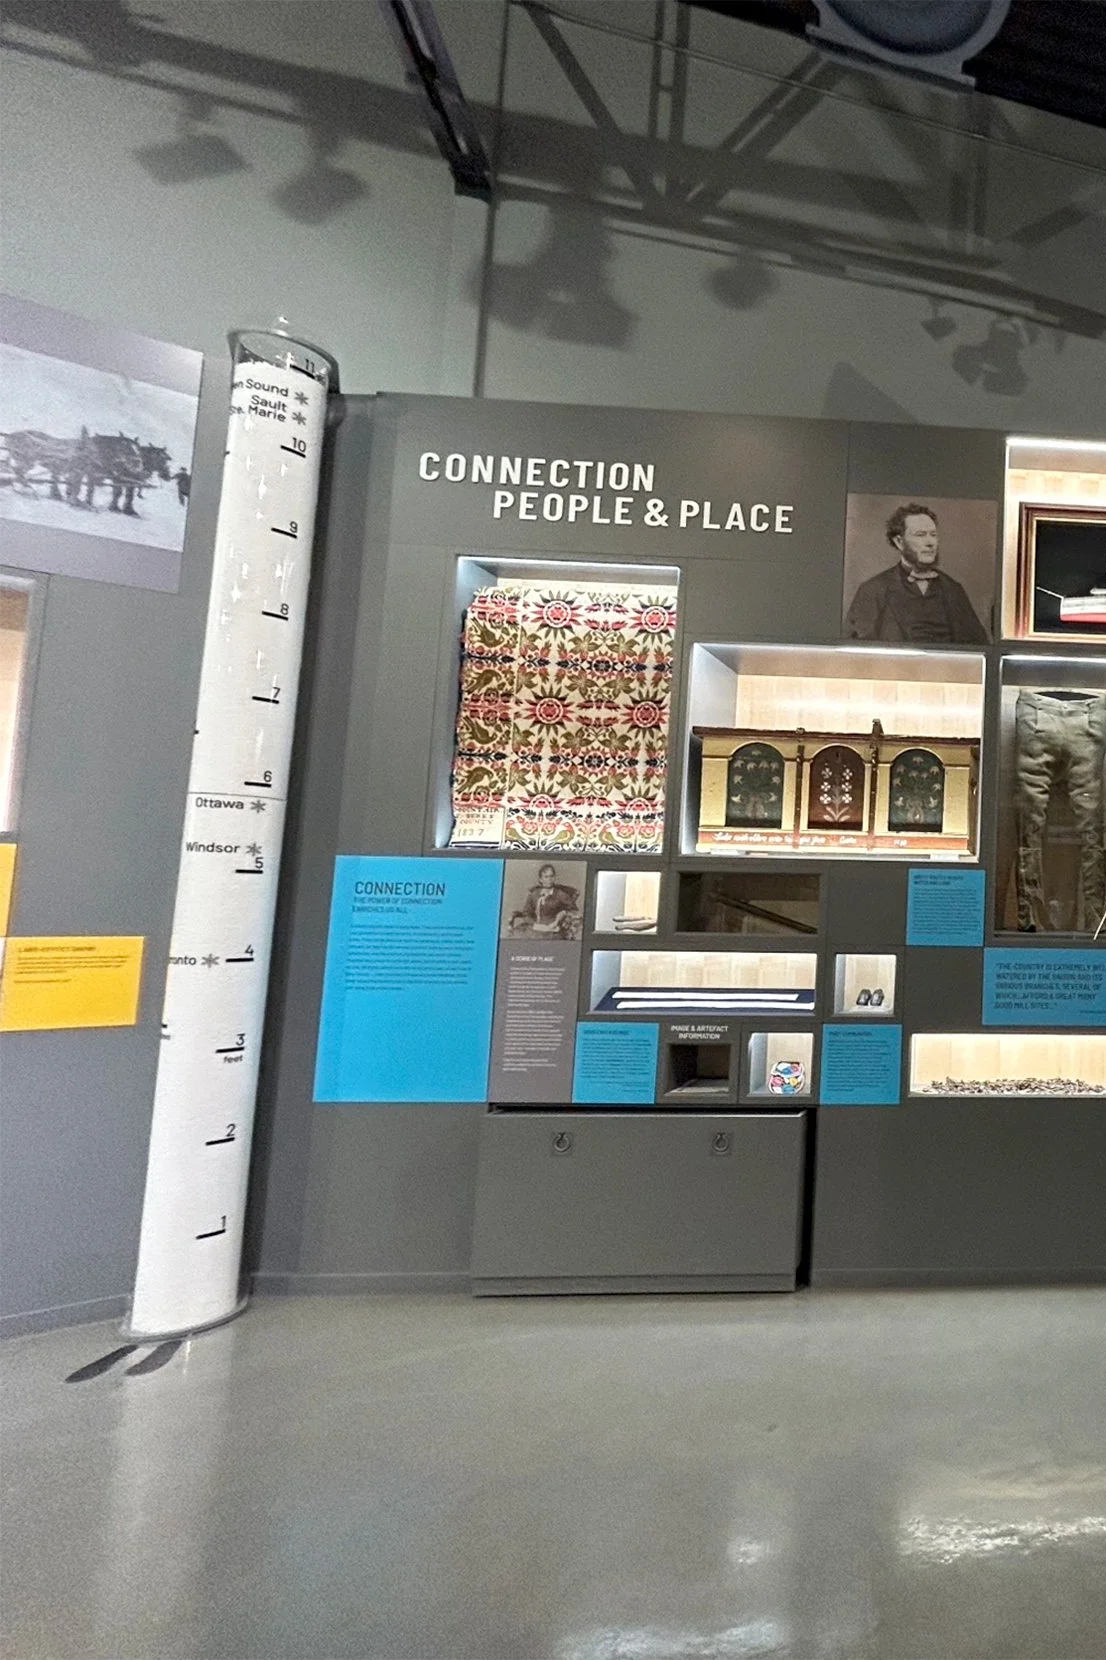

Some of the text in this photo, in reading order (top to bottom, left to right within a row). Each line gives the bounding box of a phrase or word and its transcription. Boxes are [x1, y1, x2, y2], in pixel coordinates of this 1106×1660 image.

[245, 378, 289, 397] Sound
[251, 394, 288, 412] Sault
[248, 404, 287, 422] Marie
[292, 437, 307, 453] 10
[418, 452, 656, 492] CONNECTION
[493, 490, 794, 533] PEOPLE & PLACE
[289, 521, 298, 533] 9
[280, 603, 289, 616] 8
[272, 686, 281, 698] 7
[263, 770, 272, 783] 6
[195, 797, 244, 809] Ottawa
[186, 842, 241, 853] Windsor
[254, 857, 264, 869] 5
[354, 881, 446, 896] CONNECTION
[244, 944, 254, 956] 4
[670, 1024, 690, 1032] IMAGE
[235, 1033, 246, 1046] 3
[678, 1032, 721, 1040] INFORMATION
[223, 1055, 244, 1064] feet
[226, 1123, 236, 1137] 2
[220, 1215, 227, 1228] 1
